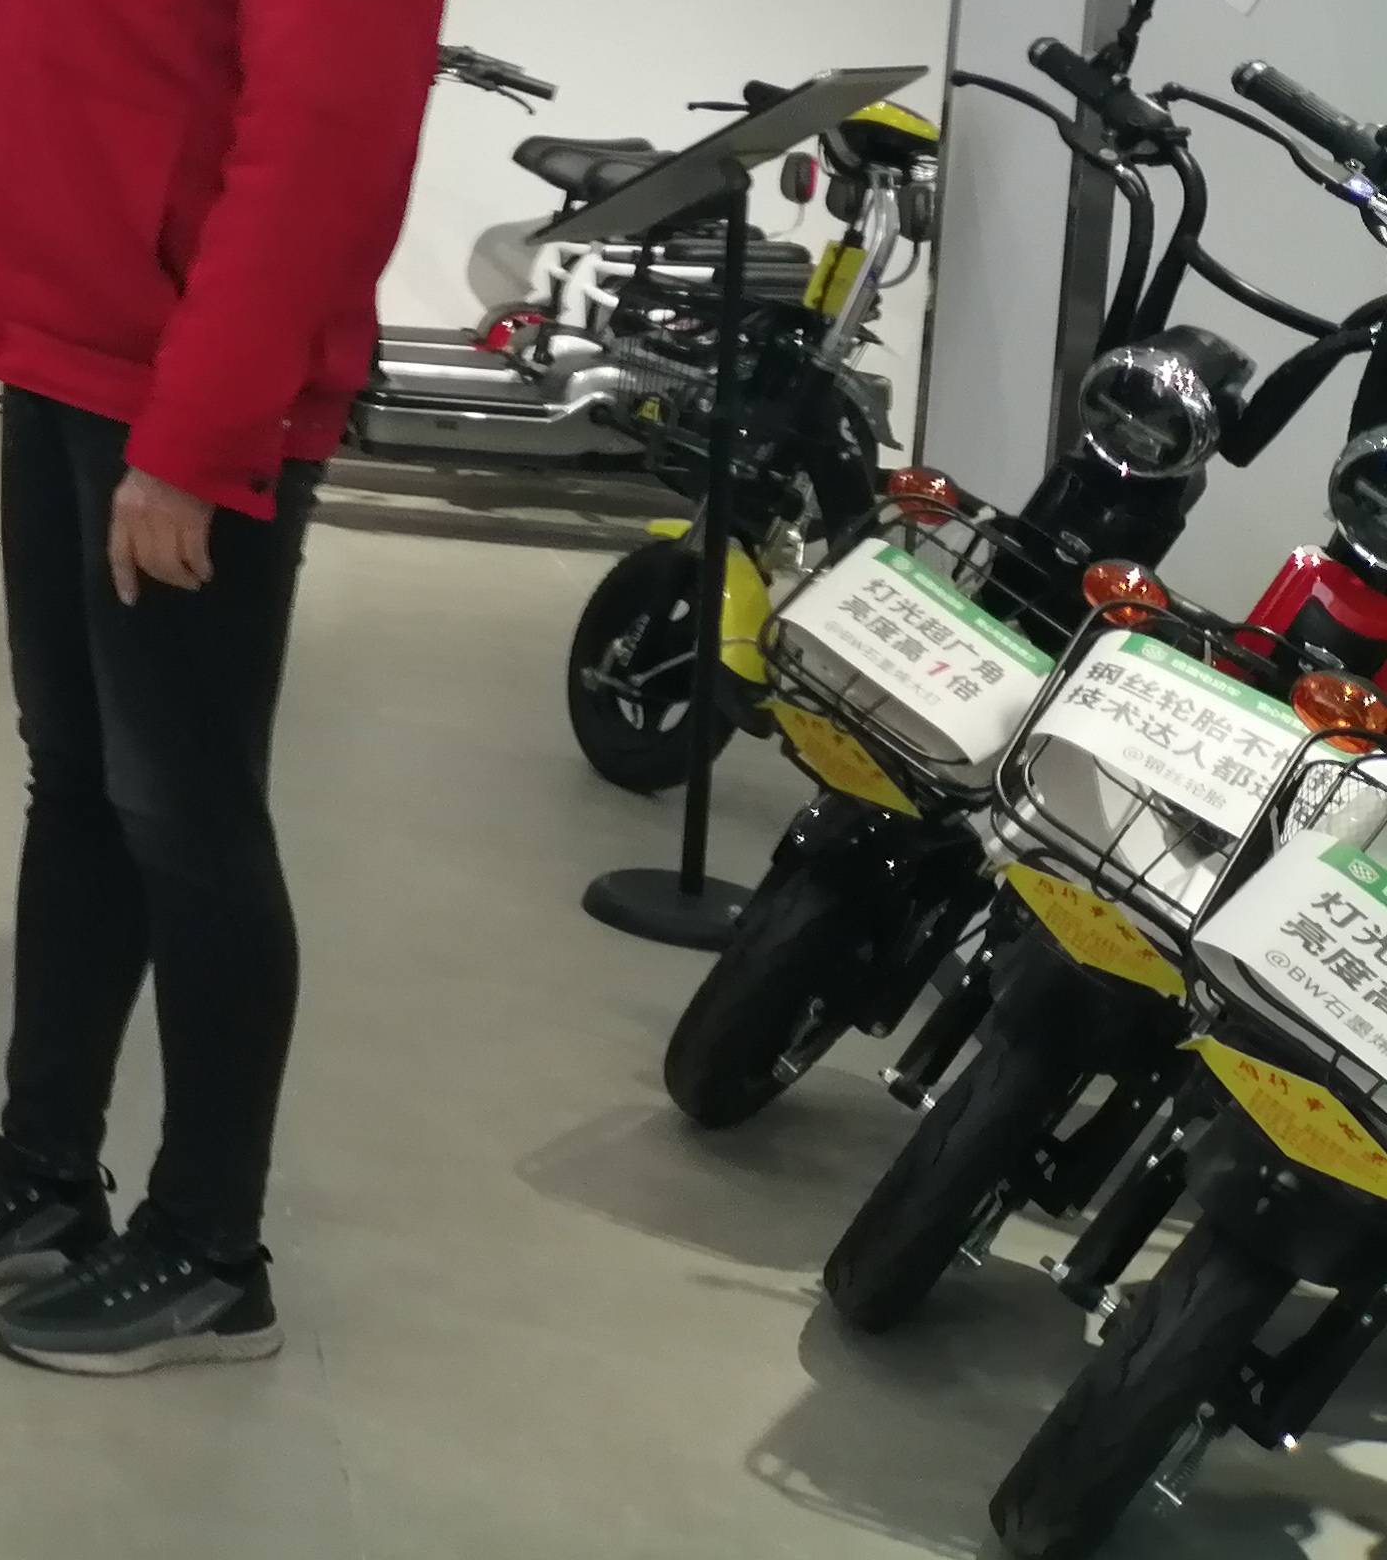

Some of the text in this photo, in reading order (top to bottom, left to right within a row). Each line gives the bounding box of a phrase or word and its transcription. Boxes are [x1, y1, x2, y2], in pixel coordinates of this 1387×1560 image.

[862, 578, 1006, 686] 灯光超广角
